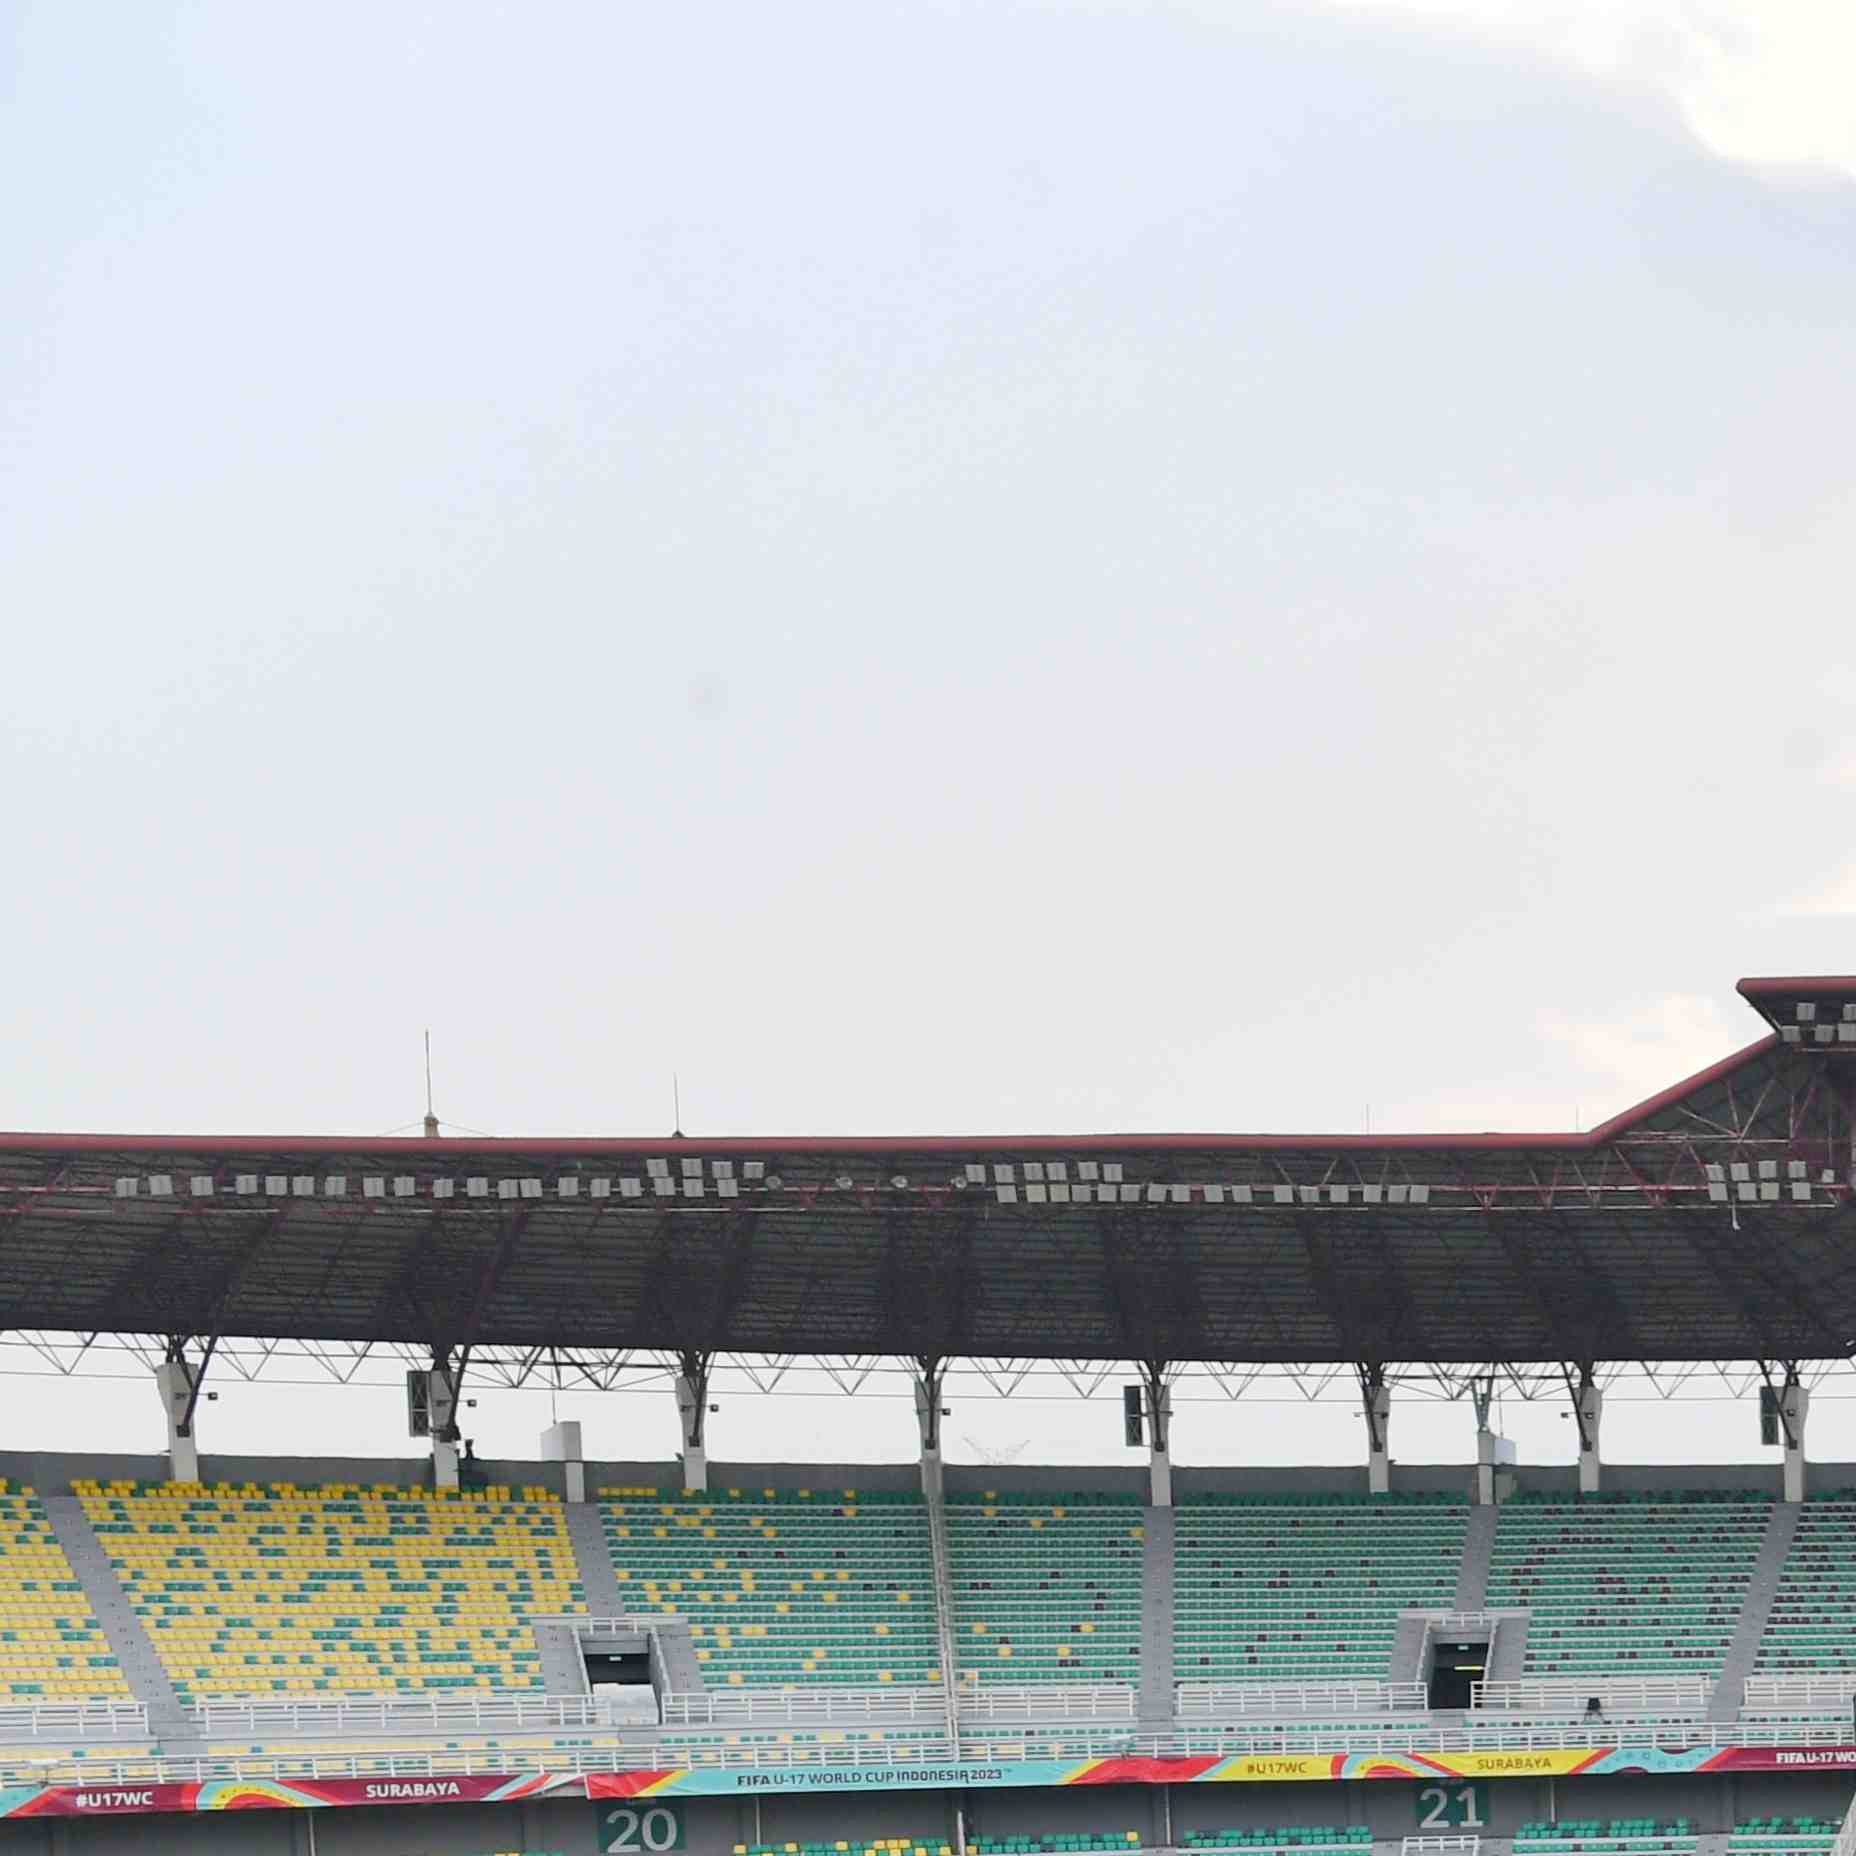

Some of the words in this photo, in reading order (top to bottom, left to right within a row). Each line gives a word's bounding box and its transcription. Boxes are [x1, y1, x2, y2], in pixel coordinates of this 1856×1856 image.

[1477, 1757, 1552, 1770] SURABAYA
[1776, 1752, 1805, 1764] FIFA
[1806, 1752, 1832, 1763] U-17
[1247, 1762, 1307, 1774] #U17WC
[737, 1775, 770, 1787] FIFA
[773, 1774, 804, 1785] U-17
[808, 1772, 862, 1785] WORLD
[865, 1771, 894, 1783] CUP
[897, 1769, 969, 1784] INDONESIA
[365, 1781, 460, 1799] SURABAYA
[75, 1791, 153, 1808] #U17WC
[1420, 1787, 1484, 1829] 21
[607, 1809, 677, 1853] 20
